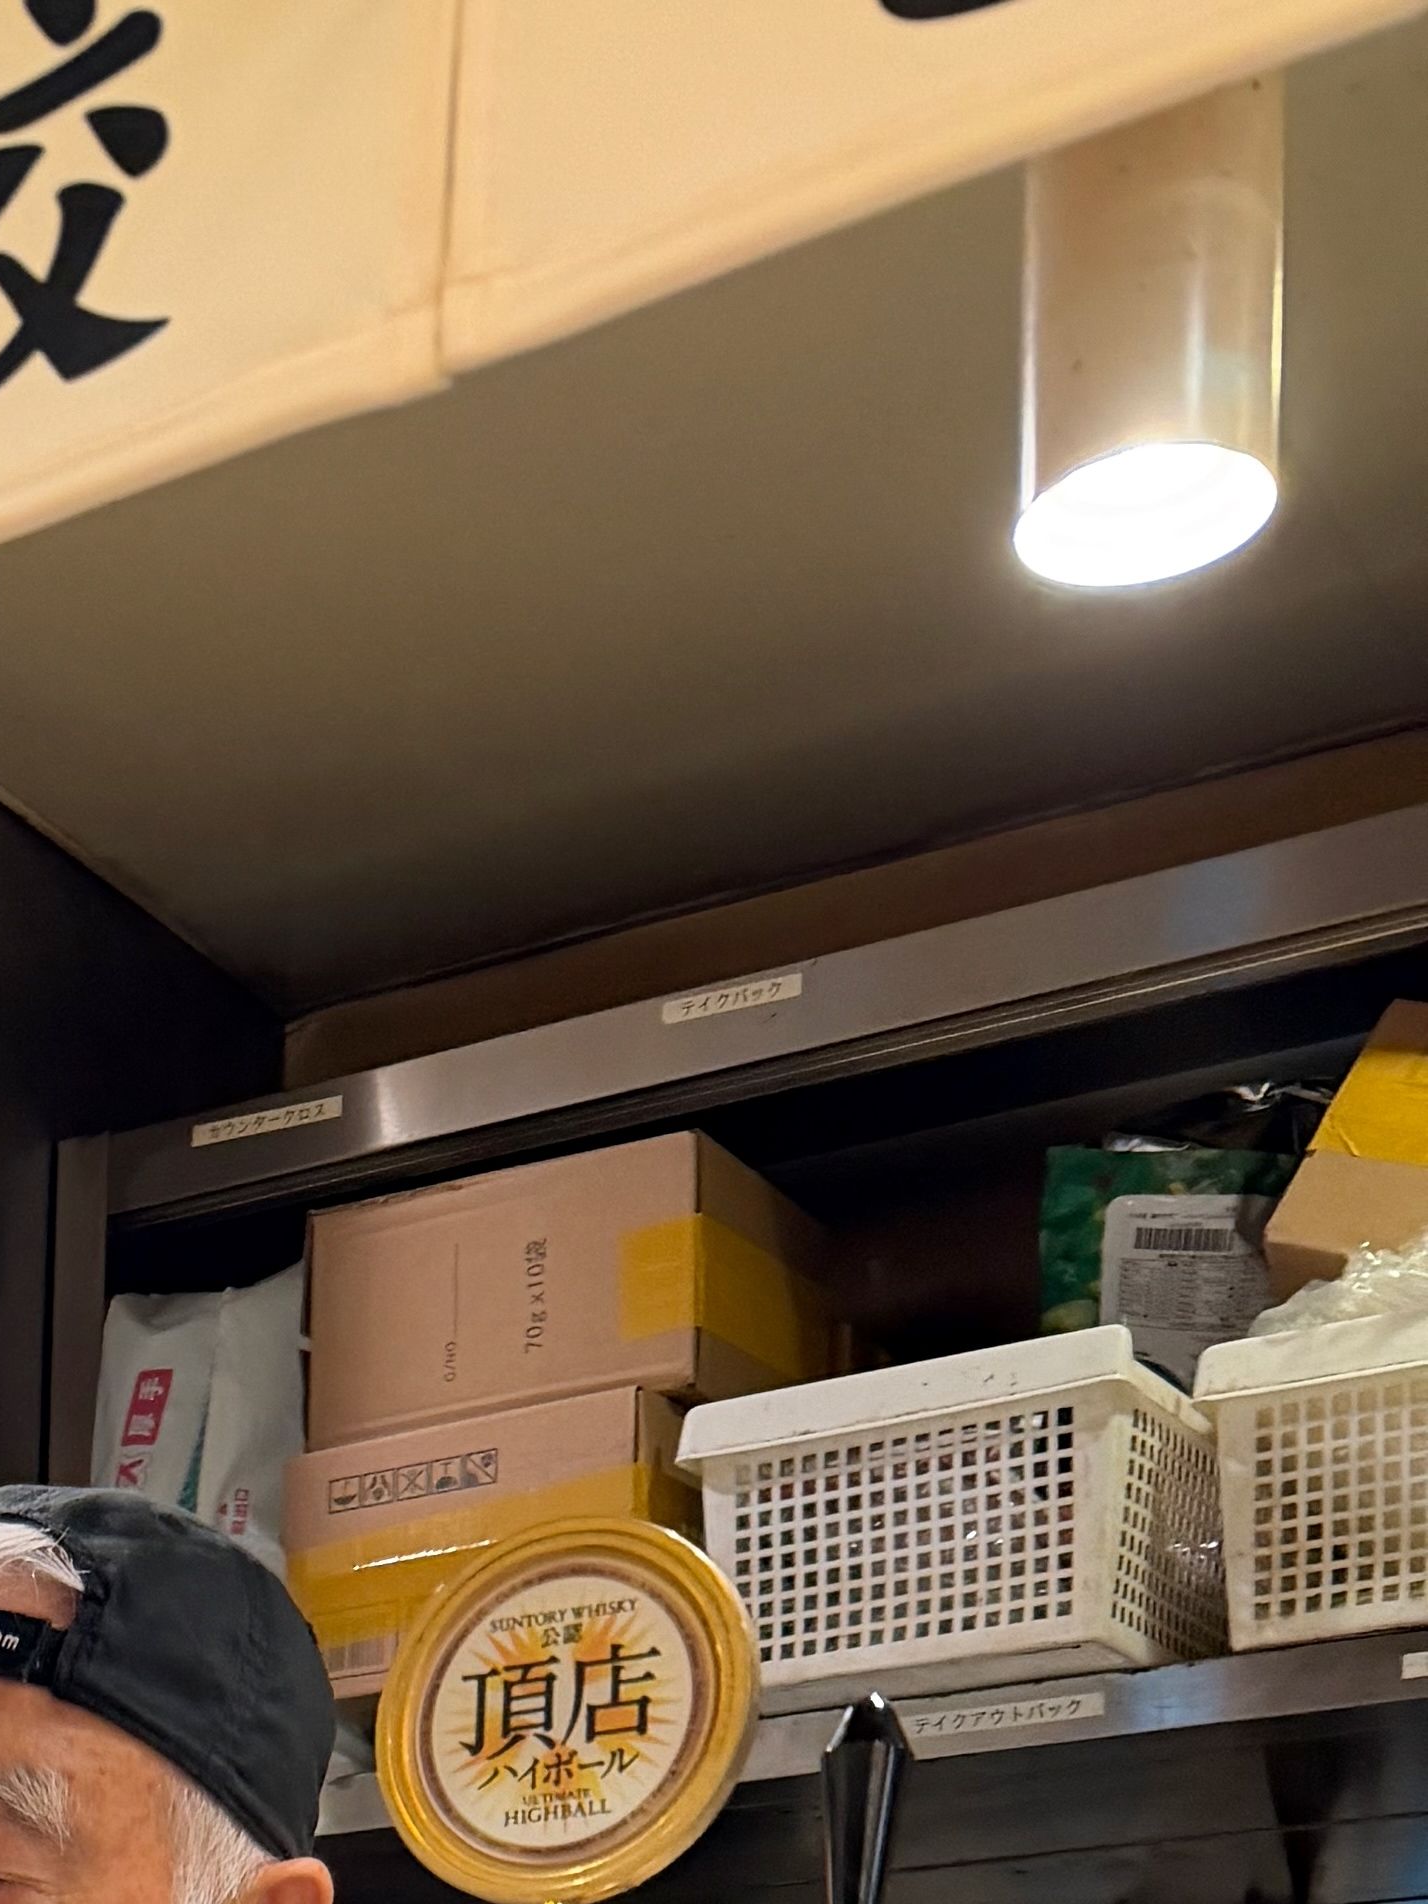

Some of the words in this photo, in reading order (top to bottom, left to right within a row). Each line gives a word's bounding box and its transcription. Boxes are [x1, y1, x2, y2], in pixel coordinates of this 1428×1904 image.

[489, 1608, 568, 1634] SUNTORY
[570, 1598, 639, 1621] WHISKY
[540, 1622, 583, 1649] 公認
[458, 1643, 662, 1760] 頂店
[477, 1747, 641, 1791] ハイボール
[503, 1797, 612, 1828] HIGHBALL
